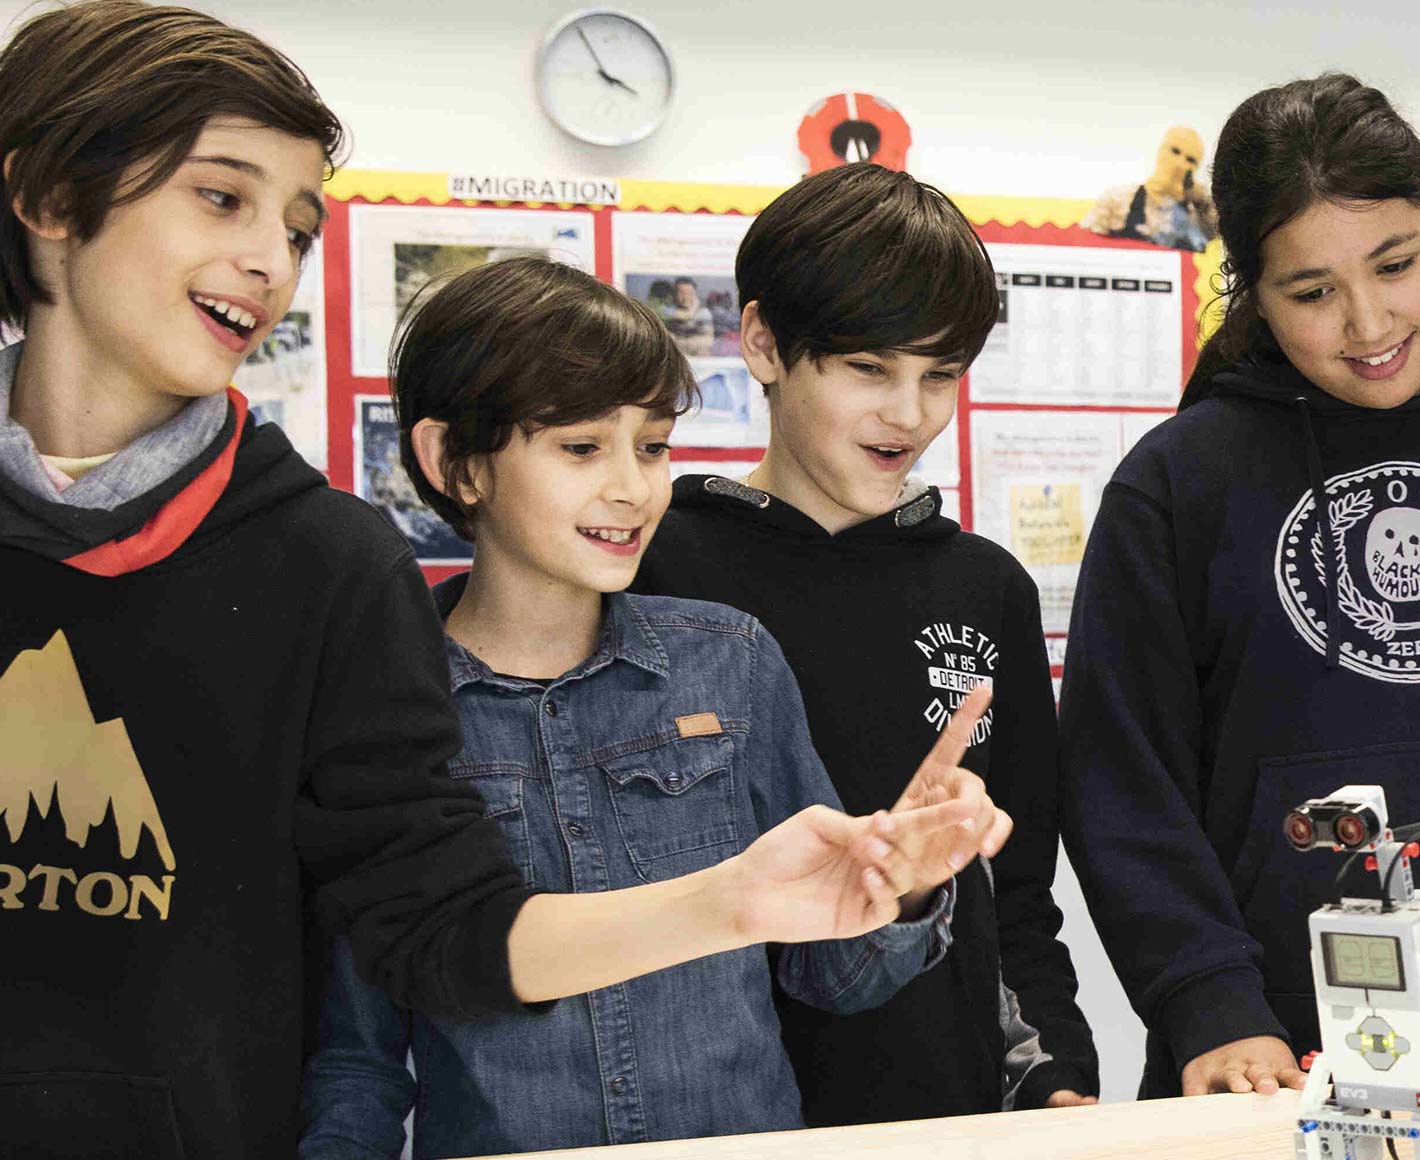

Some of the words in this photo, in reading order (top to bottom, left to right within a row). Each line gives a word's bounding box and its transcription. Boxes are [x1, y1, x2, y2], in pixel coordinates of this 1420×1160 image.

[453, 177, 618, 202] #MIGRATION
[1373, 550, 1420, 578] BLACK
[914, 623, 999, 670] ATHLETIC
[960, 655, 976, 672] 85
[1340, 1087, 1368, 1100] EV3
